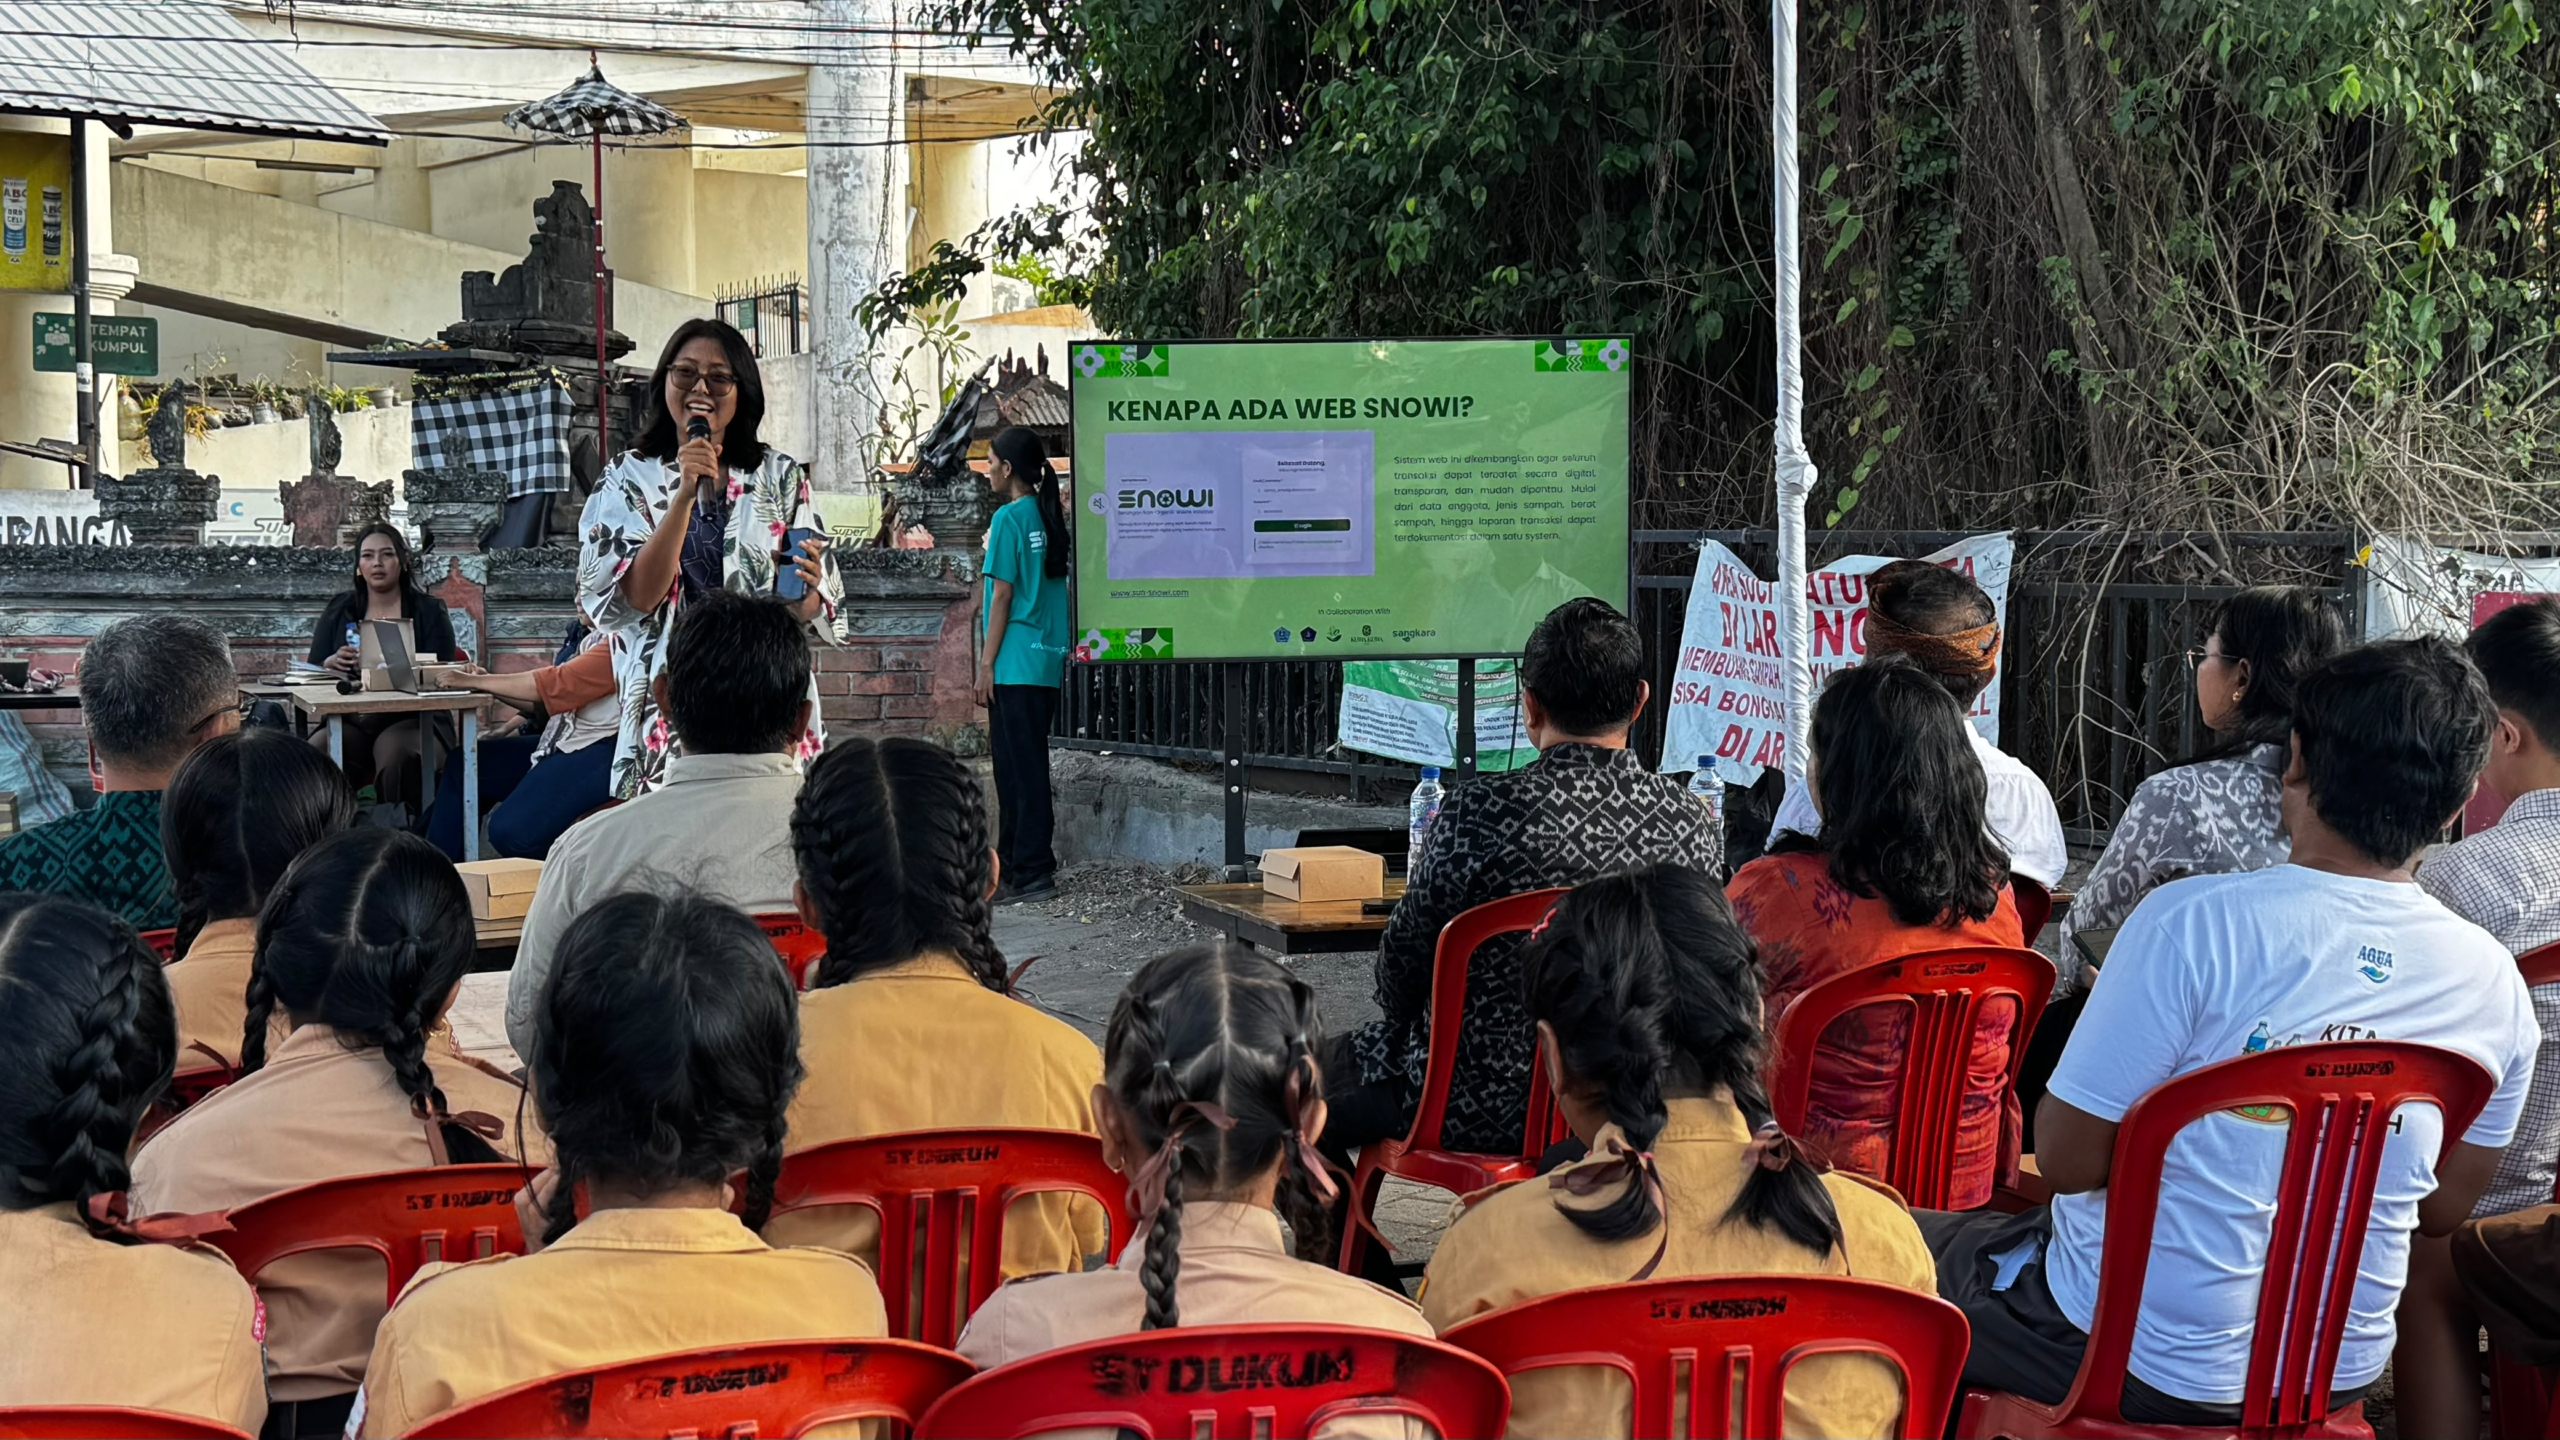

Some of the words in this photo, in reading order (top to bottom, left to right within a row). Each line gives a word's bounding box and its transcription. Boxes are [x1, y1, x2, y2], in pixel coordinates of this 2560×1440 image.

[91, 323, 148, 337] TEMPAT
[91, 340, 148, 353] KUMPUL
[1108, 399, 1221, 421] KENAPA
[1228, 399, 1288, 420] ADA
[1295, 398, 1357, 420] WEB
[1363, 395, 1474, 419] SNOWI?
[1394, 456, 1426, 464] Sistem
[1428, 456, 1448, 464] web
[1451, 455, 1462, 463] ini
[1537, 455, 1559, 465] agar
[1394, 471, 1437, 480] transaksi
[1444, 471, 1472, 480] dapat
[1525, 470, 1557, 478] secara
[1394, 487, 1449, 497] transparan,
[1455, 486, 1474, 495] dan
[1480, 486, 1514, 495] mudah
[1571, 483, 1596, 493] Mulai
[1394, 502, 1414, 511] dari
[1419, 502, 1442, 511] data
[1448, 502, 1490, 512] anggota,
[1495, 501, 1518, 511] jenis
[1571, 499, 1596, 509] berat
[254, 518, 291, 535] Sup
[1394, 518, 1435, 529] sampah,
[1441, 518, 1473, 528] hingga
[1479, 517, 1515, 528] laporan
[1521, 515, 1563, 525] transaksi
[1567, 515, 1596, 526] dapat
[1394, 533, 1468, 542] terdokumentasi
[1469, 533, 1499, 541] dalam
[1503, 533, 1523, 541] satu
[1738, 572, 1772, 604] SUCI
[1720, 601, 1738, 650] DI
[1392, 628, 1436, 639] sangkara
[1673, 681, 1711, 707] SISA
[1715, 723, 1754, 763] DI
[2357, 945, 2393, 968] AQUA
[2320, 1023, 2378, 1041] KITA
